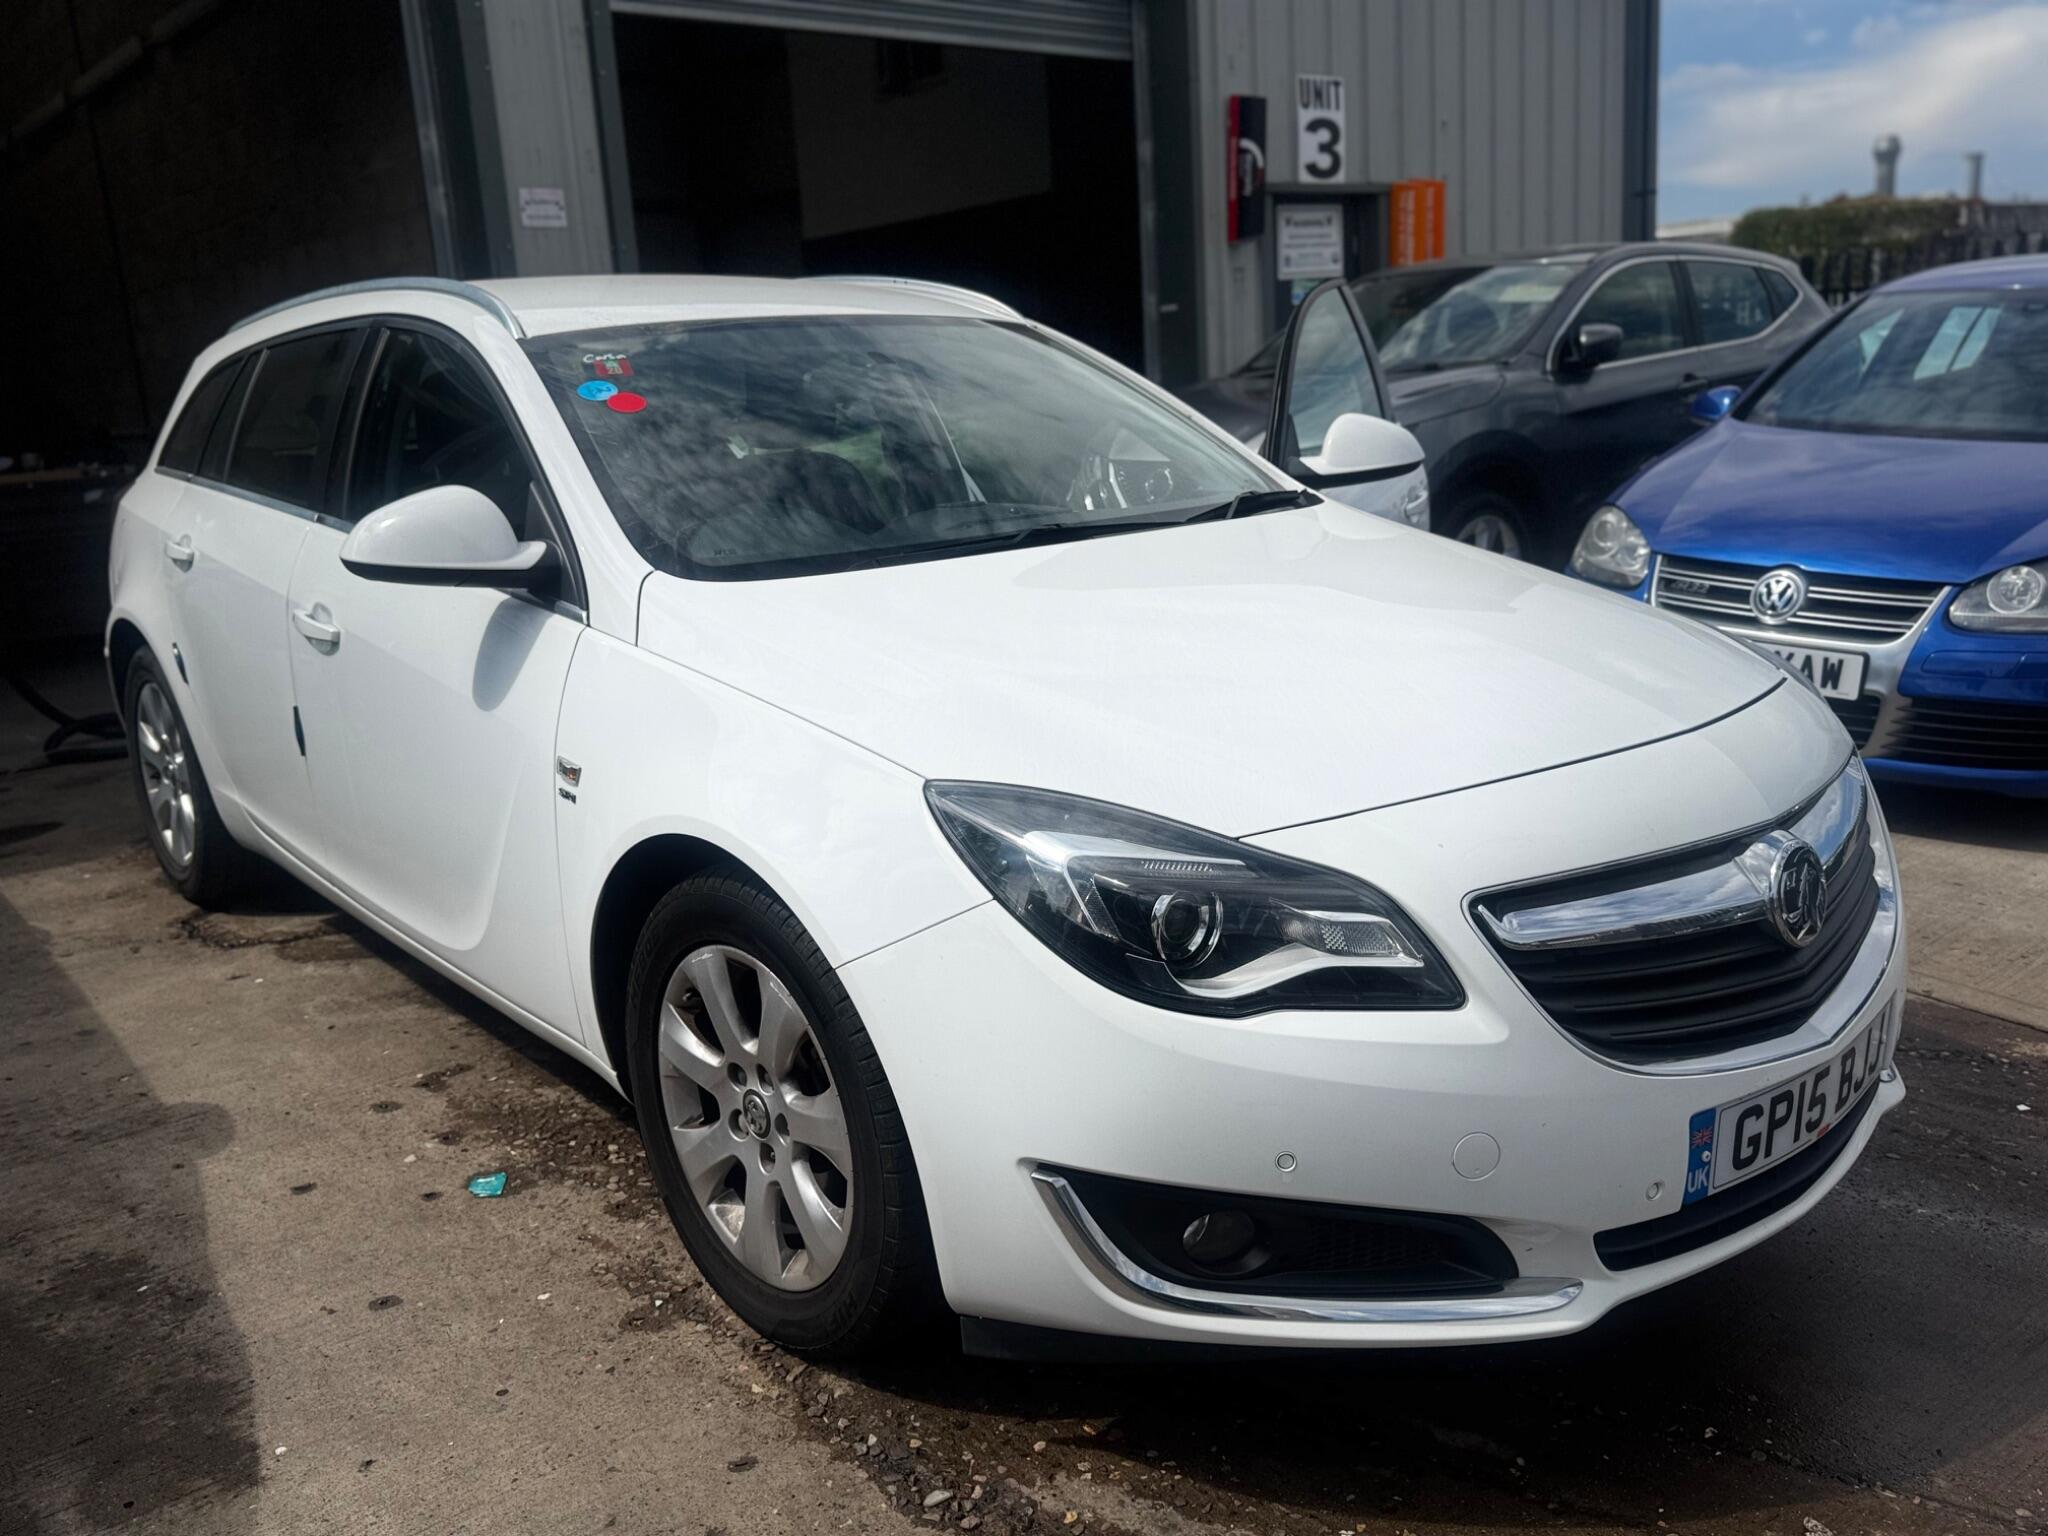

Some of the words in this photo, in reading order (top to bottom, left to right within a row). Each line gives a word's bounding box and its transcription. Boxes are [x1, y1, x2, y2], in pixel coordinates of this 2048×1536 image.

[1299, 78, 1342, 110] UNIT
[1304, 118, 1342, 179] 3
[1774, 650, 1844, 690] AW
[1731, 1065, 1830, 1171] GP15
[1687, 1166, 1710, 1193] UK
